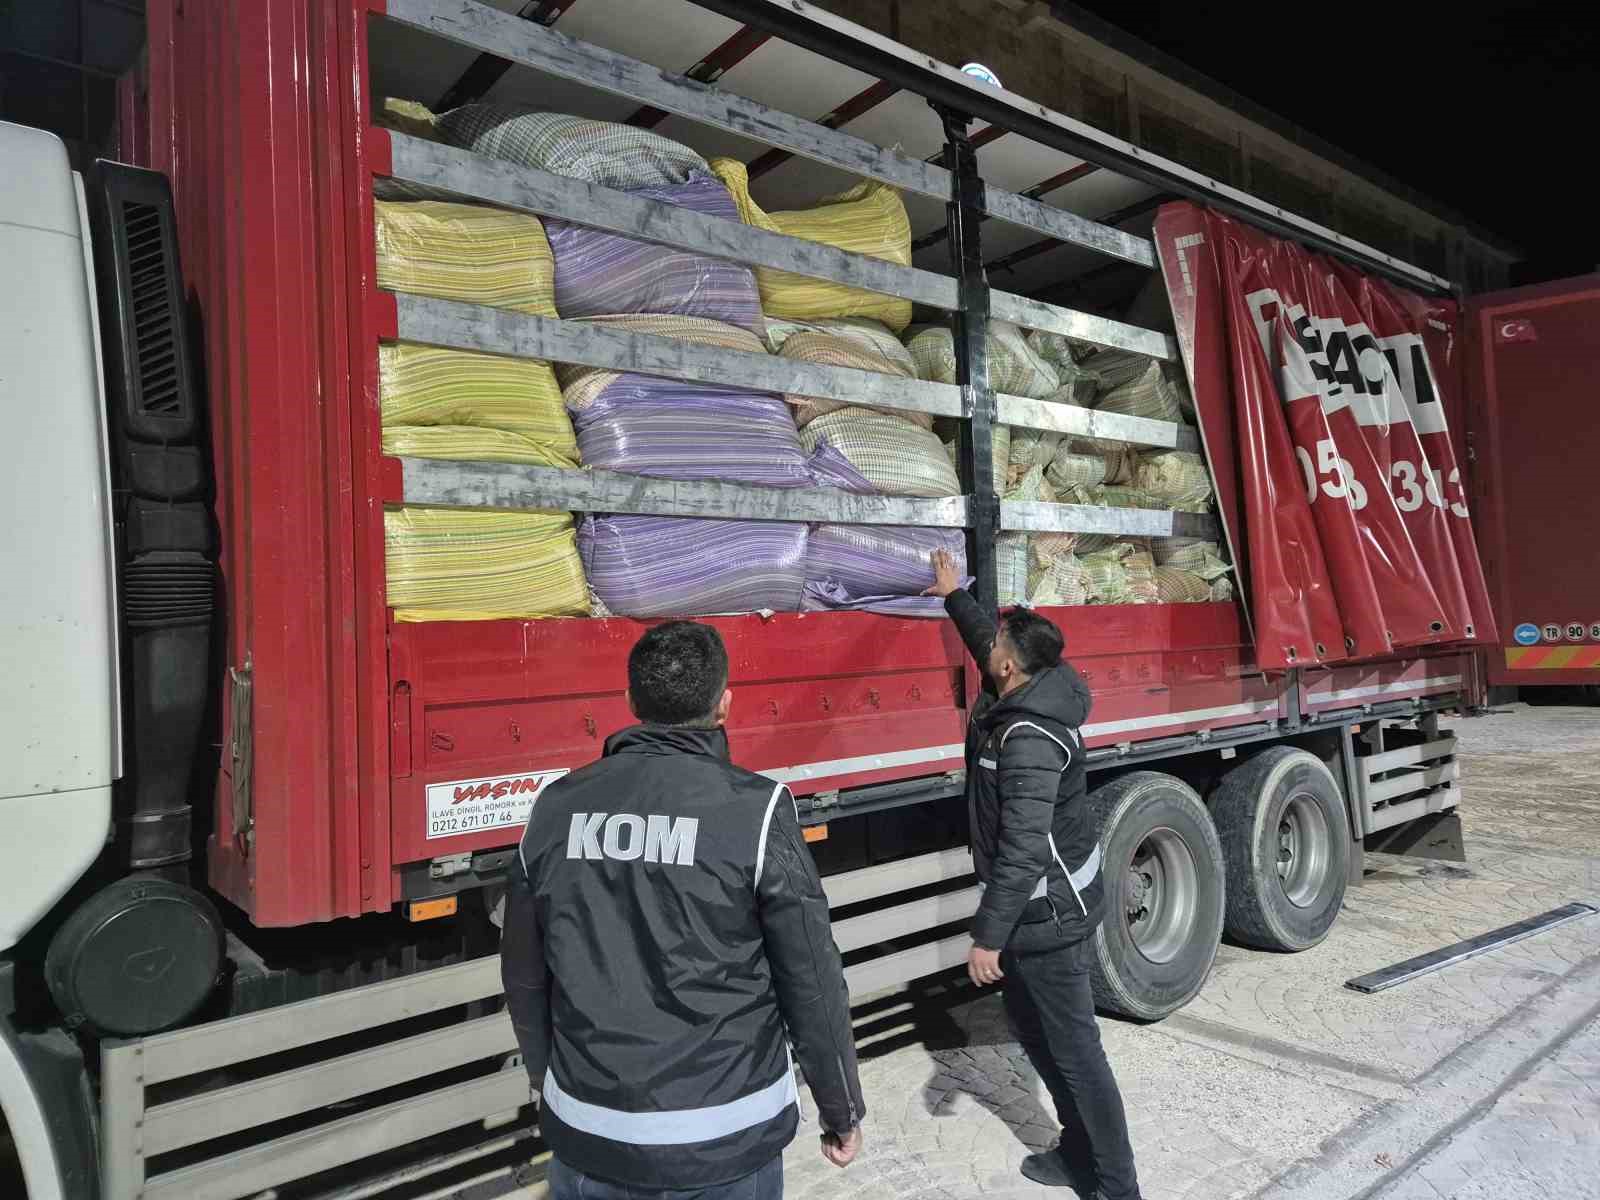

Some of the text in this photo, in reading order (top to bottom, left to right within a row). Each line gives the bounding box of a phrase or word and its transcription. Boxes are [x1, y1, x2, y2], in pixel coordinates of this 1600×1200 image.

[1545, 627, 1558, 638] TR
[1568, 626, 1583, 637] 90
[432, 810, 512, 831] 0212 671 07 46
[566, 813, 699, 867] KOM
